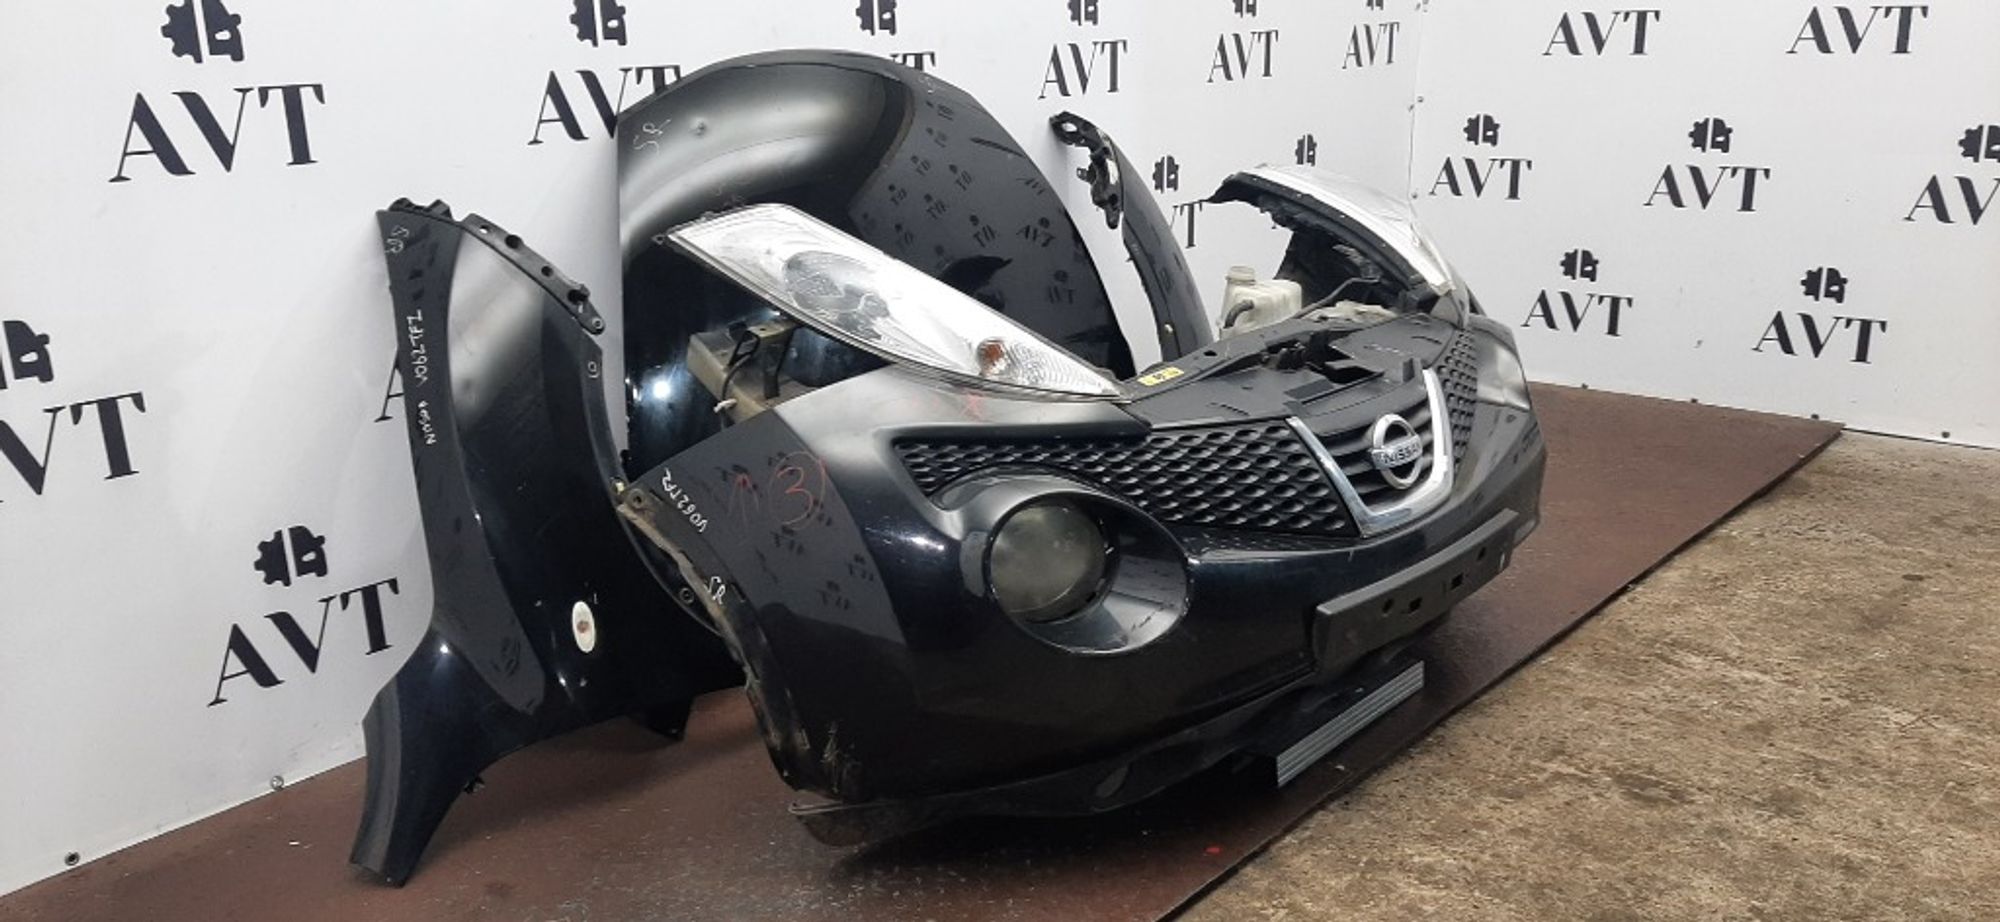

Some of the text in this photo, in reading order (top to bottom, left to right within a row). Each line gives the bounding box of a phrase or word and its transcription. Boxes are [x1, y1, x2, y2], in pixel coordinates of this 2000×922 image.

[1342, 21, 1400, 69] AVT
[1542, 9, 1661, 56] AVT
[1786, 5, 1929, 54] AVT
[1039, 39, 1128, 98] AVT
[1207, 29, 1279, 83] AVT
[108, 83, 326, 183] AVT
[1428, 156, 1533, 200] AVT
[1642, 164, 1771, 212] AVT
[1903, 174, 2000, 225] AV
[1520, 289, 1634, 338] AVT
[1751, 310, 1888, 365] AVT
[0, 390, 146, 495] VT
[206, 576, 400, 708] AVT
